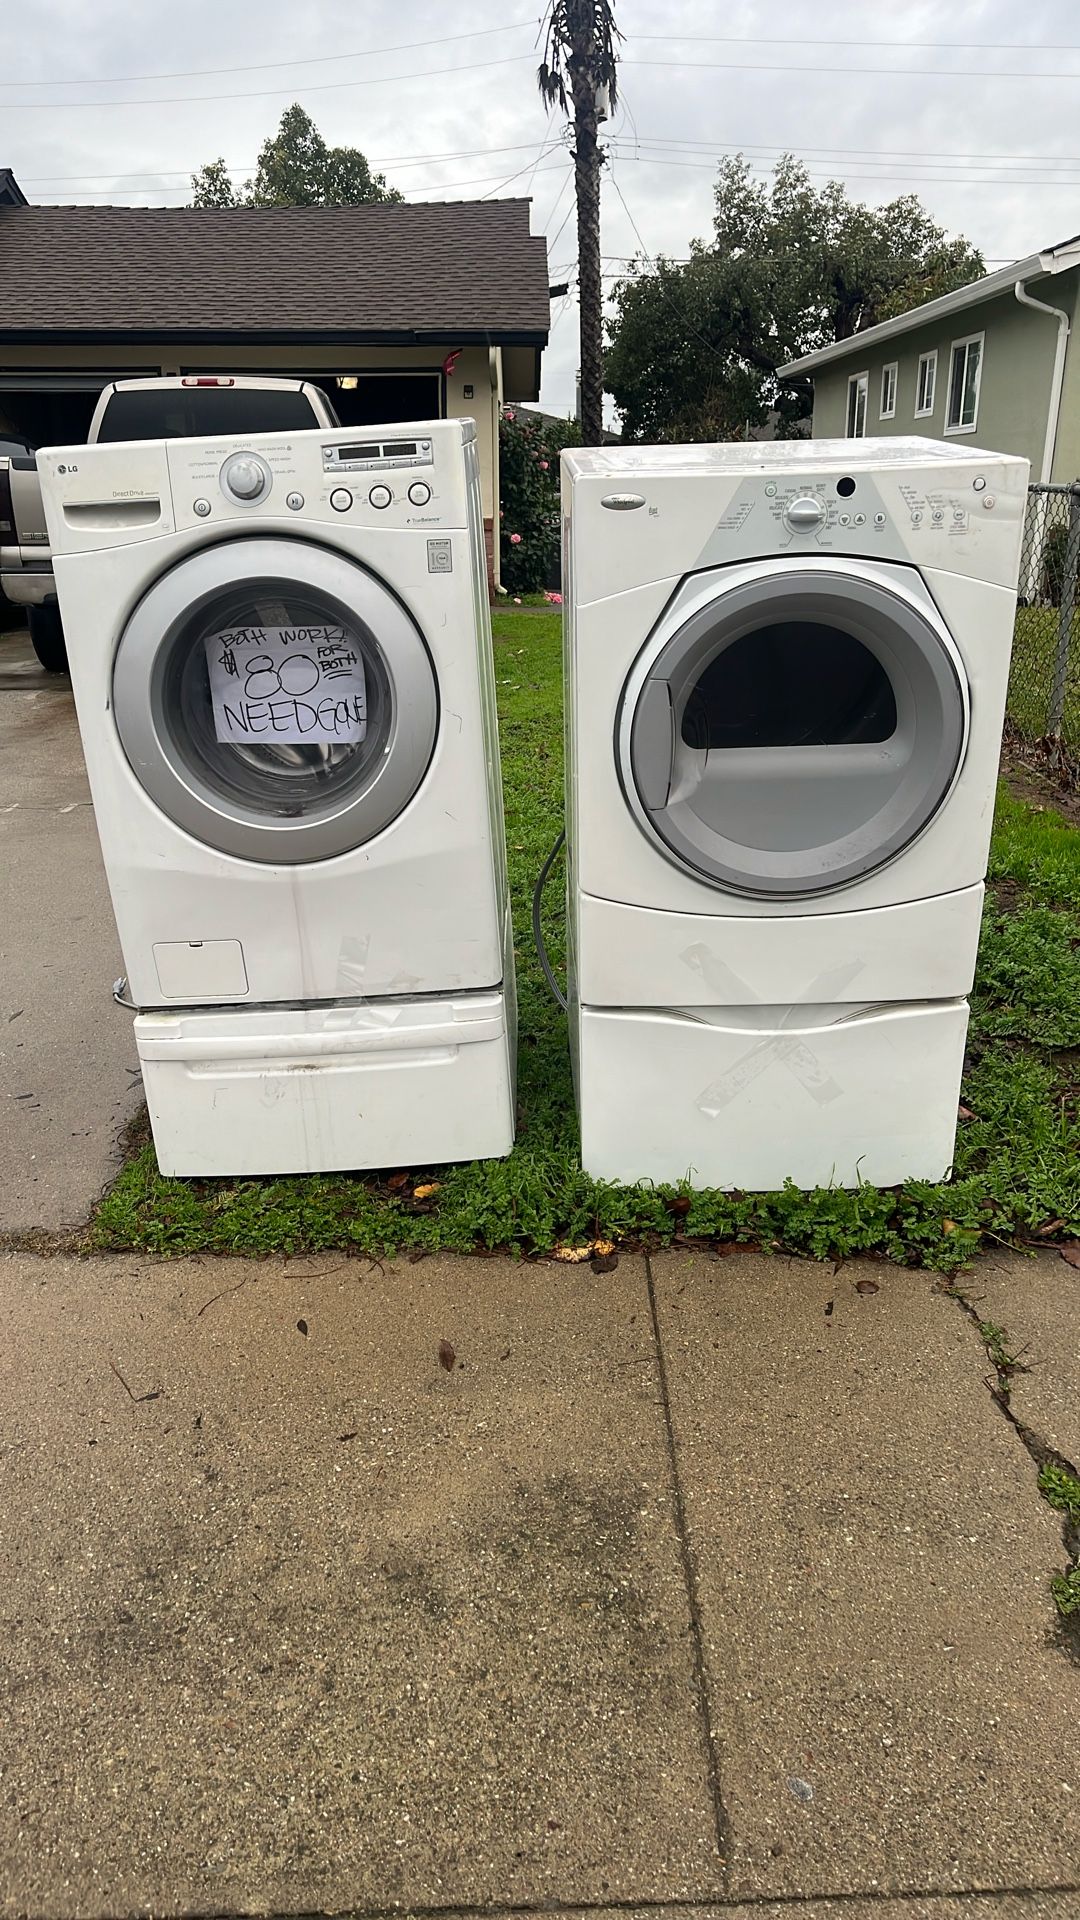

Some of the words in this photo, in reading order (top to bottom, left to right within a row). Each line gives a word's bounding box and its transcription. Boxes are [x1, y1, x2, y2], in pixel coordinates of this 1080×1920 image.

[67, 465, 78, 473] LG
[218, 628, 267, 648] BOTH
[317, 644, 348, 659] FOR
[319, 652, 358, 672] BOTH
[223, 699, 317, 734] NEED
